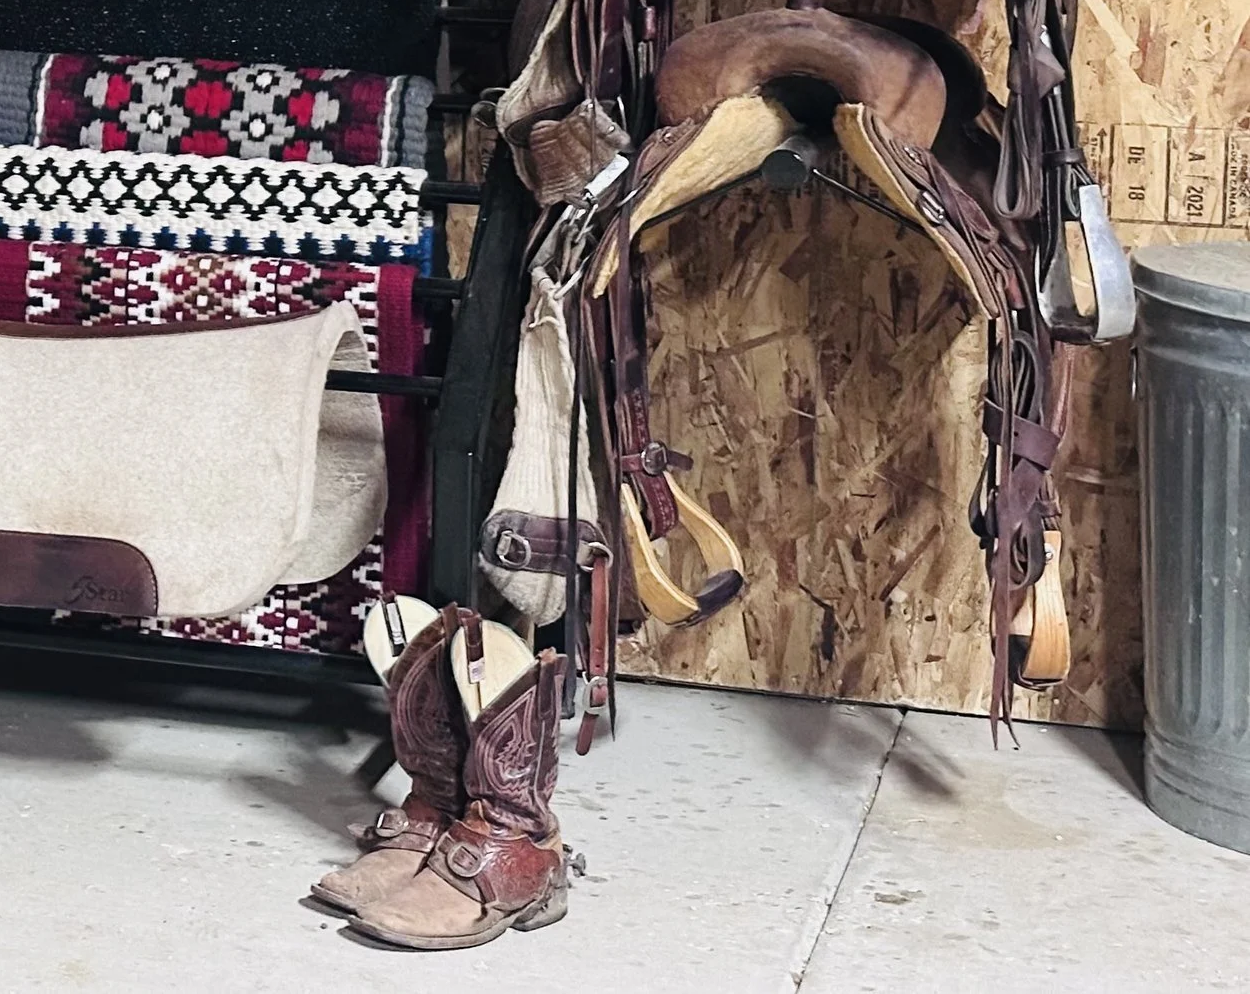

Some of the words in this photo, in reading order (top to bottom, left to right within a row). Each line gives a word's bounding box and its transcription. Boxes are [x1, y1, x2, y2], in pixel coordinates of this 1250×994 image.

[1127, 146, 1146, 165] DE
[1187, 151, 1207, 163] A
[1127, 185, 1146, 201] 18
[1185, 185, 1205, 218] 2021
